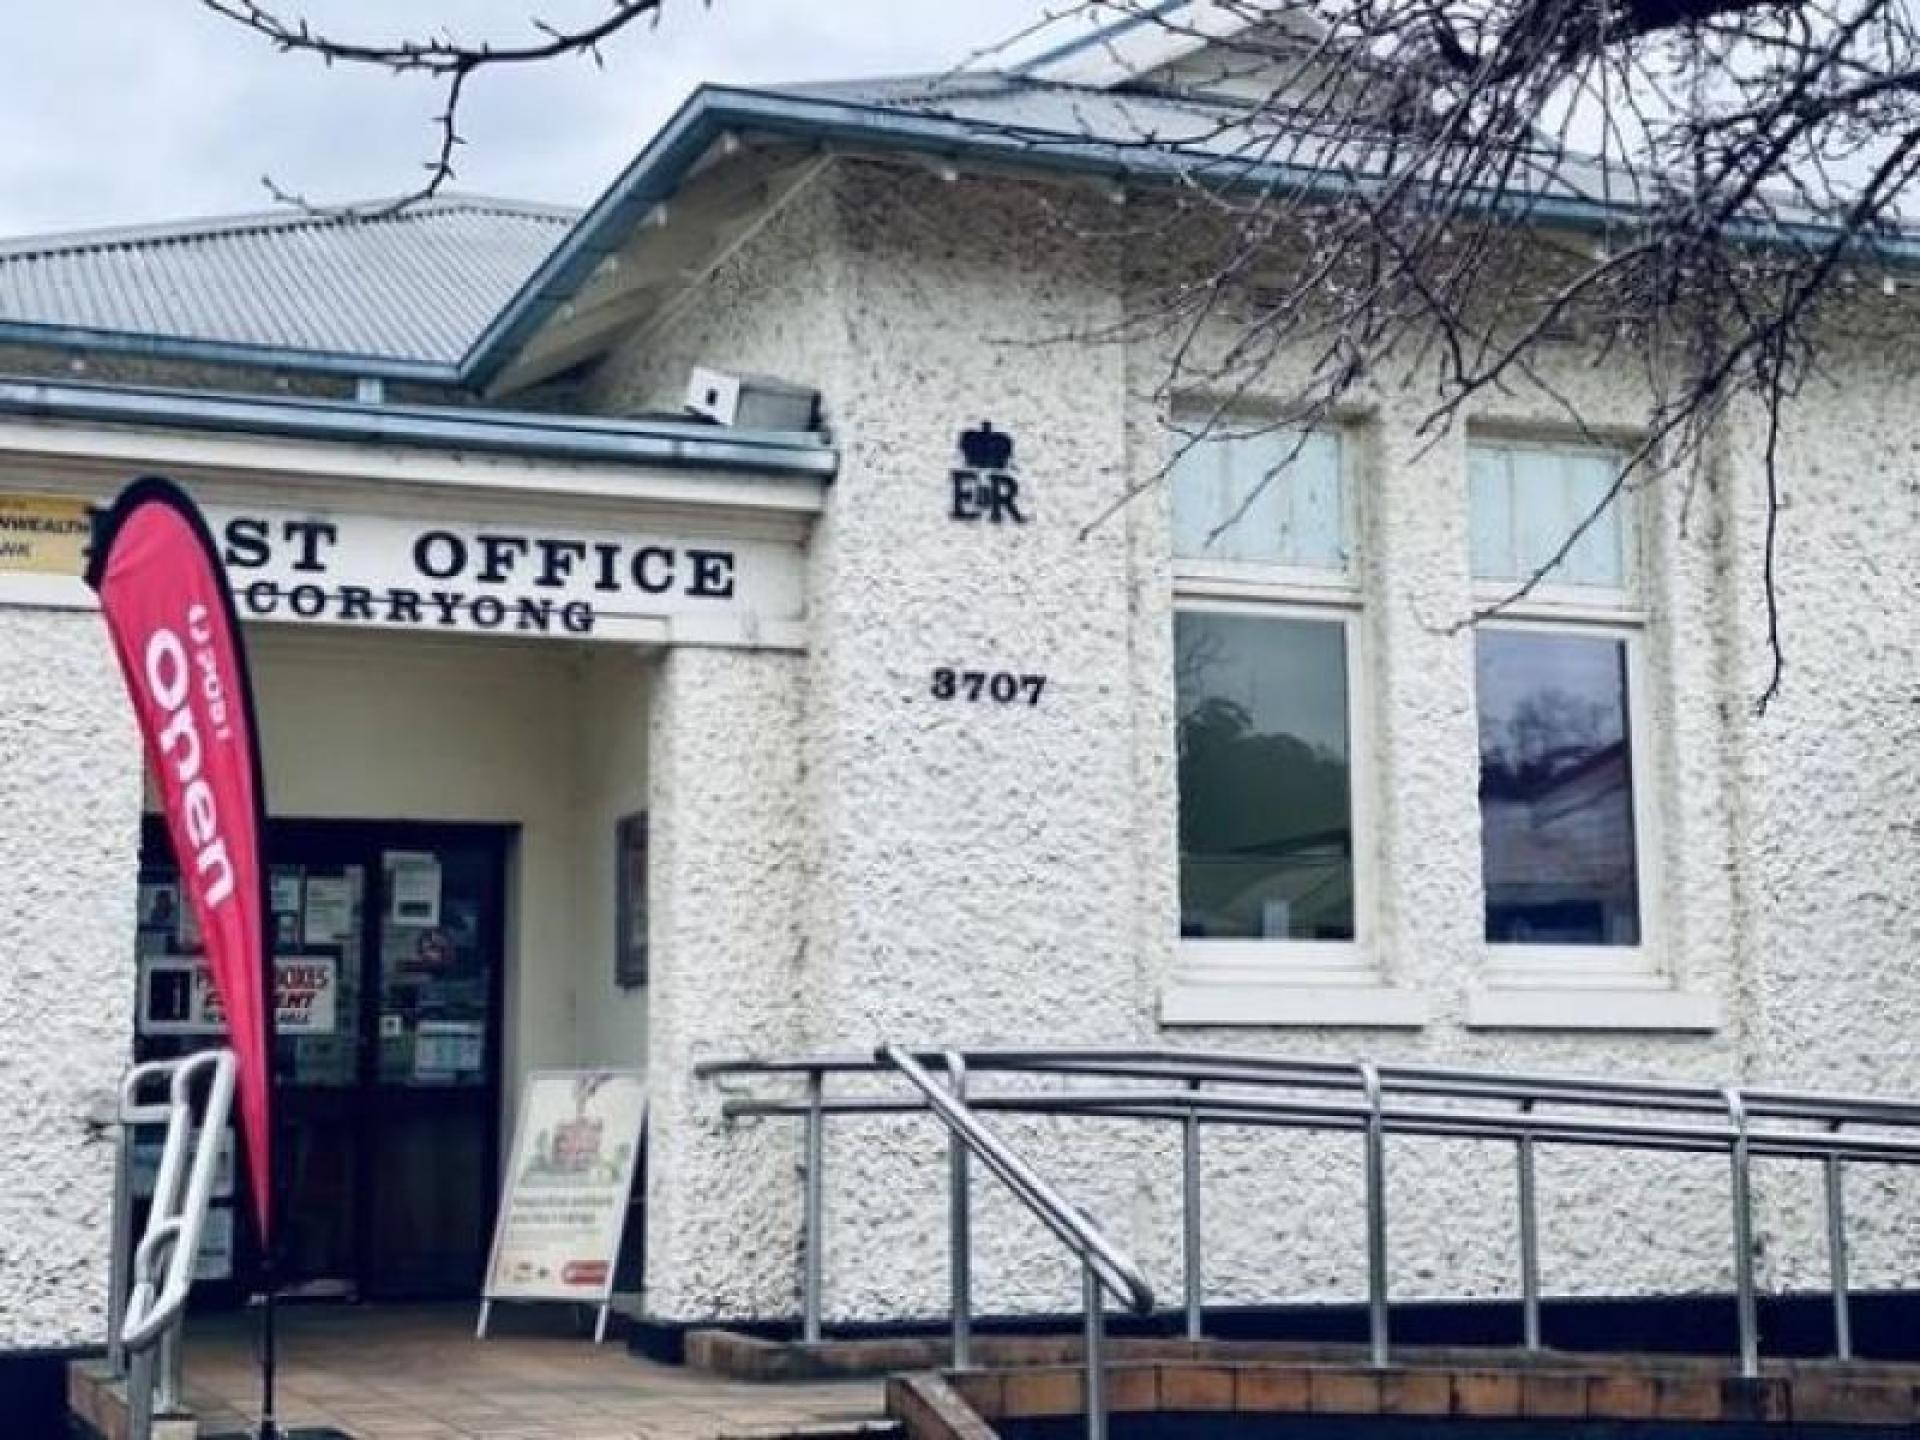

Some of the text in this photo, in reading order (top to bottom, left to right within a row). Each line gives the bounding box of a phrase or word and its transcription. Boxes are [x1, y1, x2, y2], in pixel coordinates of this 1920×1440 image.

[225, 517, 735, 599] ST OFFICE
[246, 580, 595, 633] CORRYONG
[930, 666, 1047, 708] 3707
